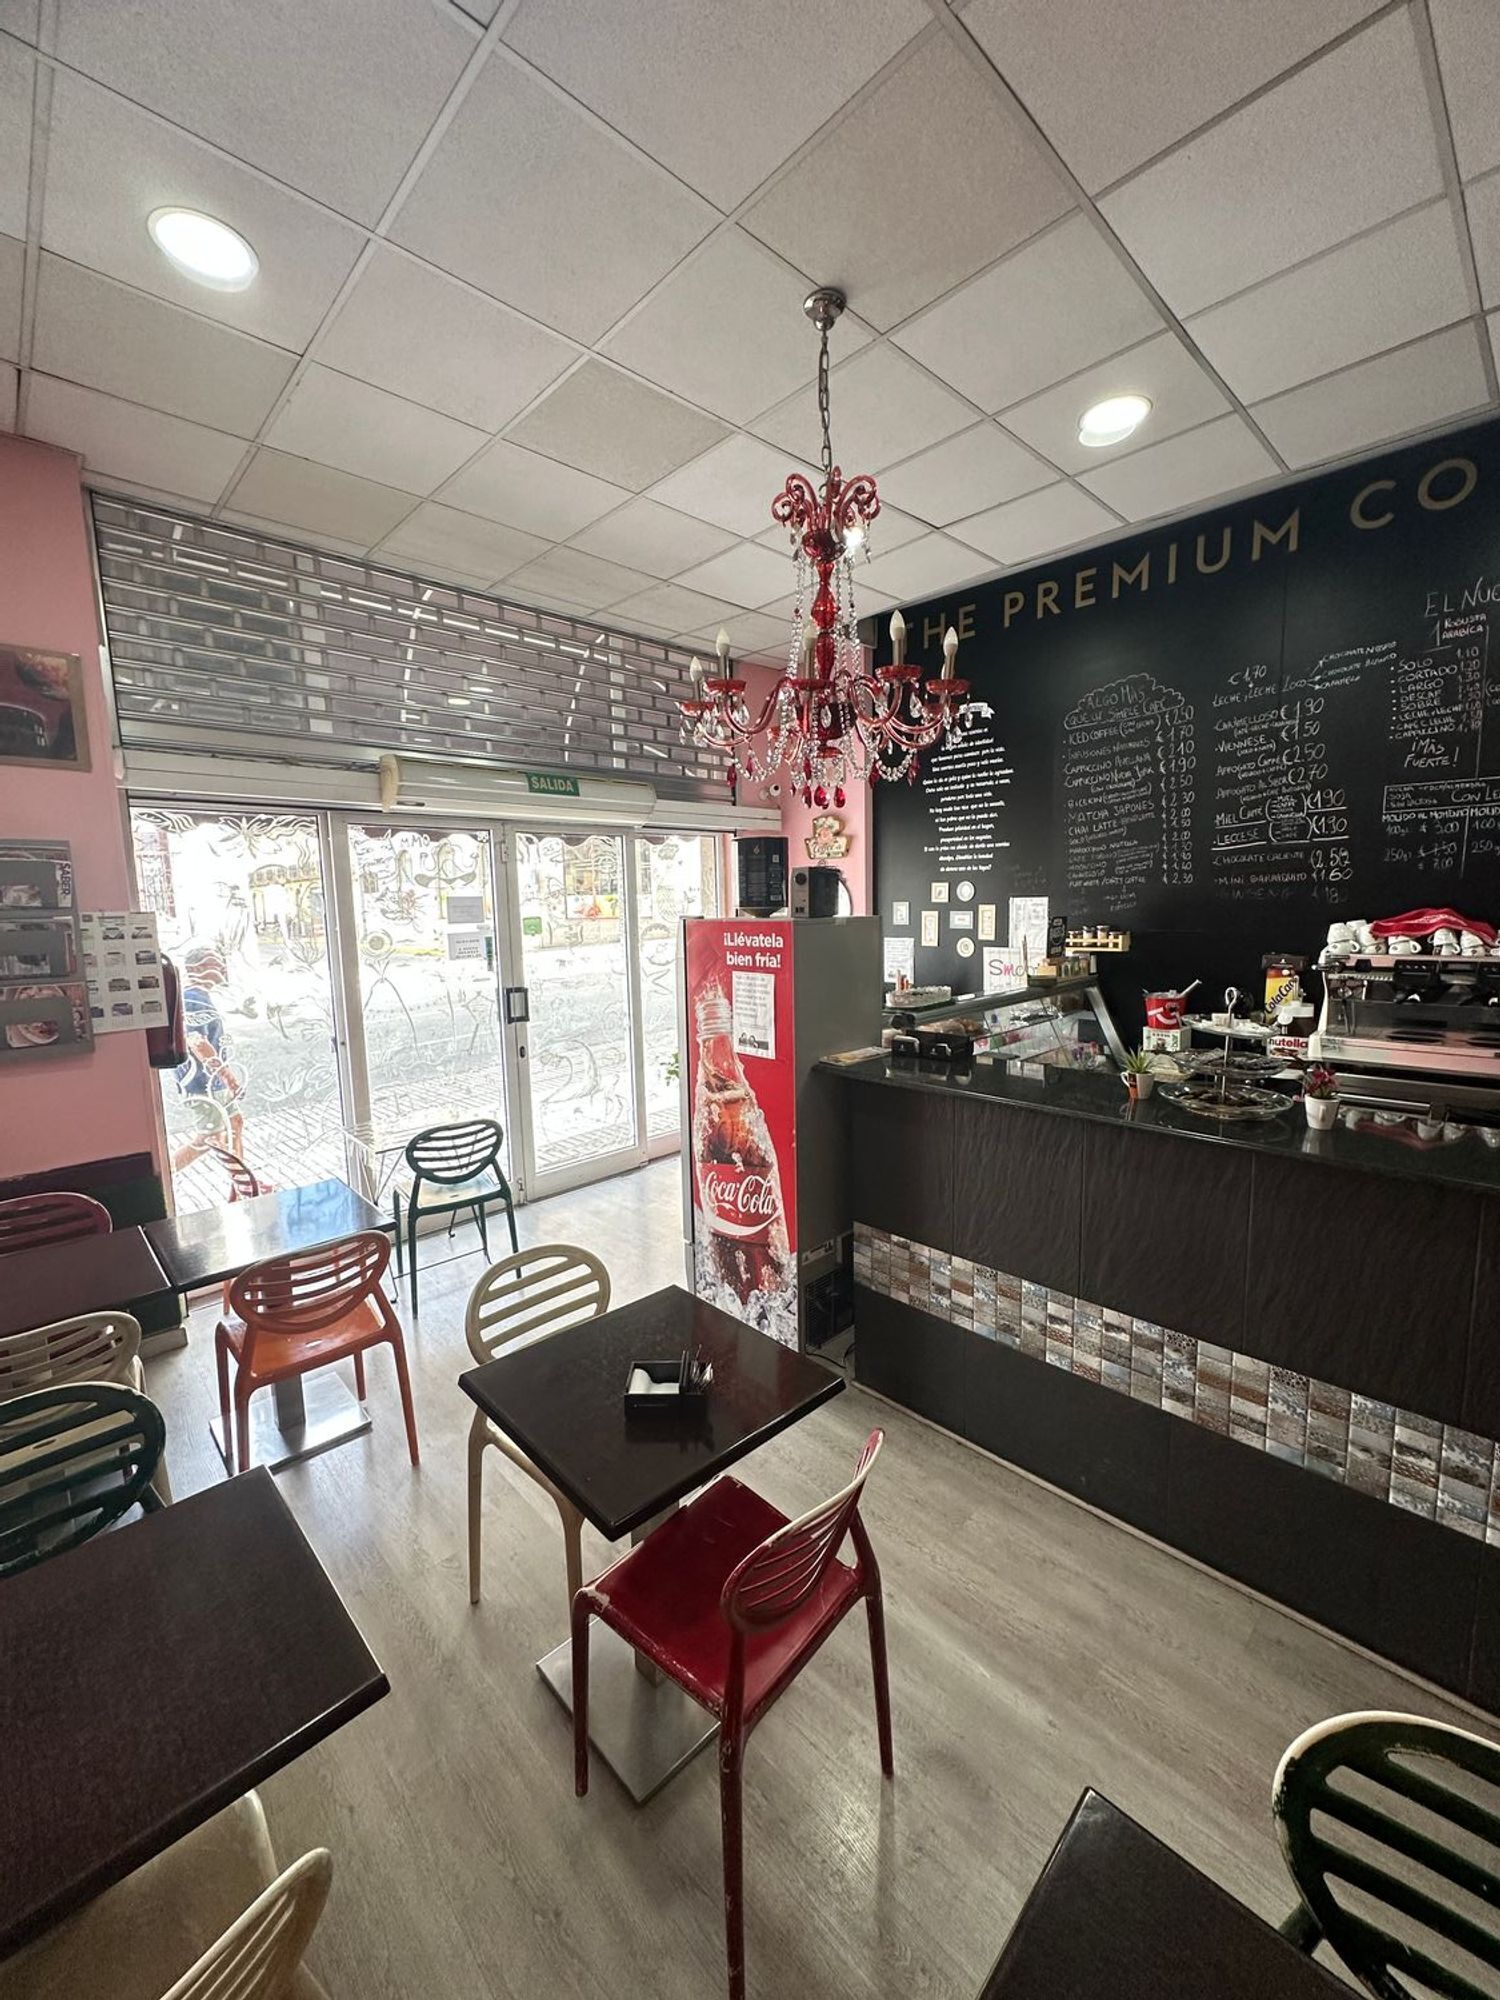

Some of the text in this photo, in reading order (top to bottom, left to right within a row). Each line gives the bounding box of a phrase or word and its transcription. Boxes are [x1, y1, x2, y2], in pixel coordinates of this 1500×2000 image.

[1003, 509, 1300, 628] PREMIUM
[1349, 457, 1478, 531] CO
[1398, 658, 1433, 673] SOLO
[1398, 664, 1458, 683] CORTADO
[1400, 678, 1444, 694] LARGO
[1400, 699, 1441, 711] SOBRE
[530, 776, 575, 792] SALIDA
[723, 932, 784, 948] ¡Llévatela
[726, 952, 781, 968] bien fría!
[1269, 1037, 1309, 1049] nutella
[704, 1171, 774, 1215] Coca-Cola
